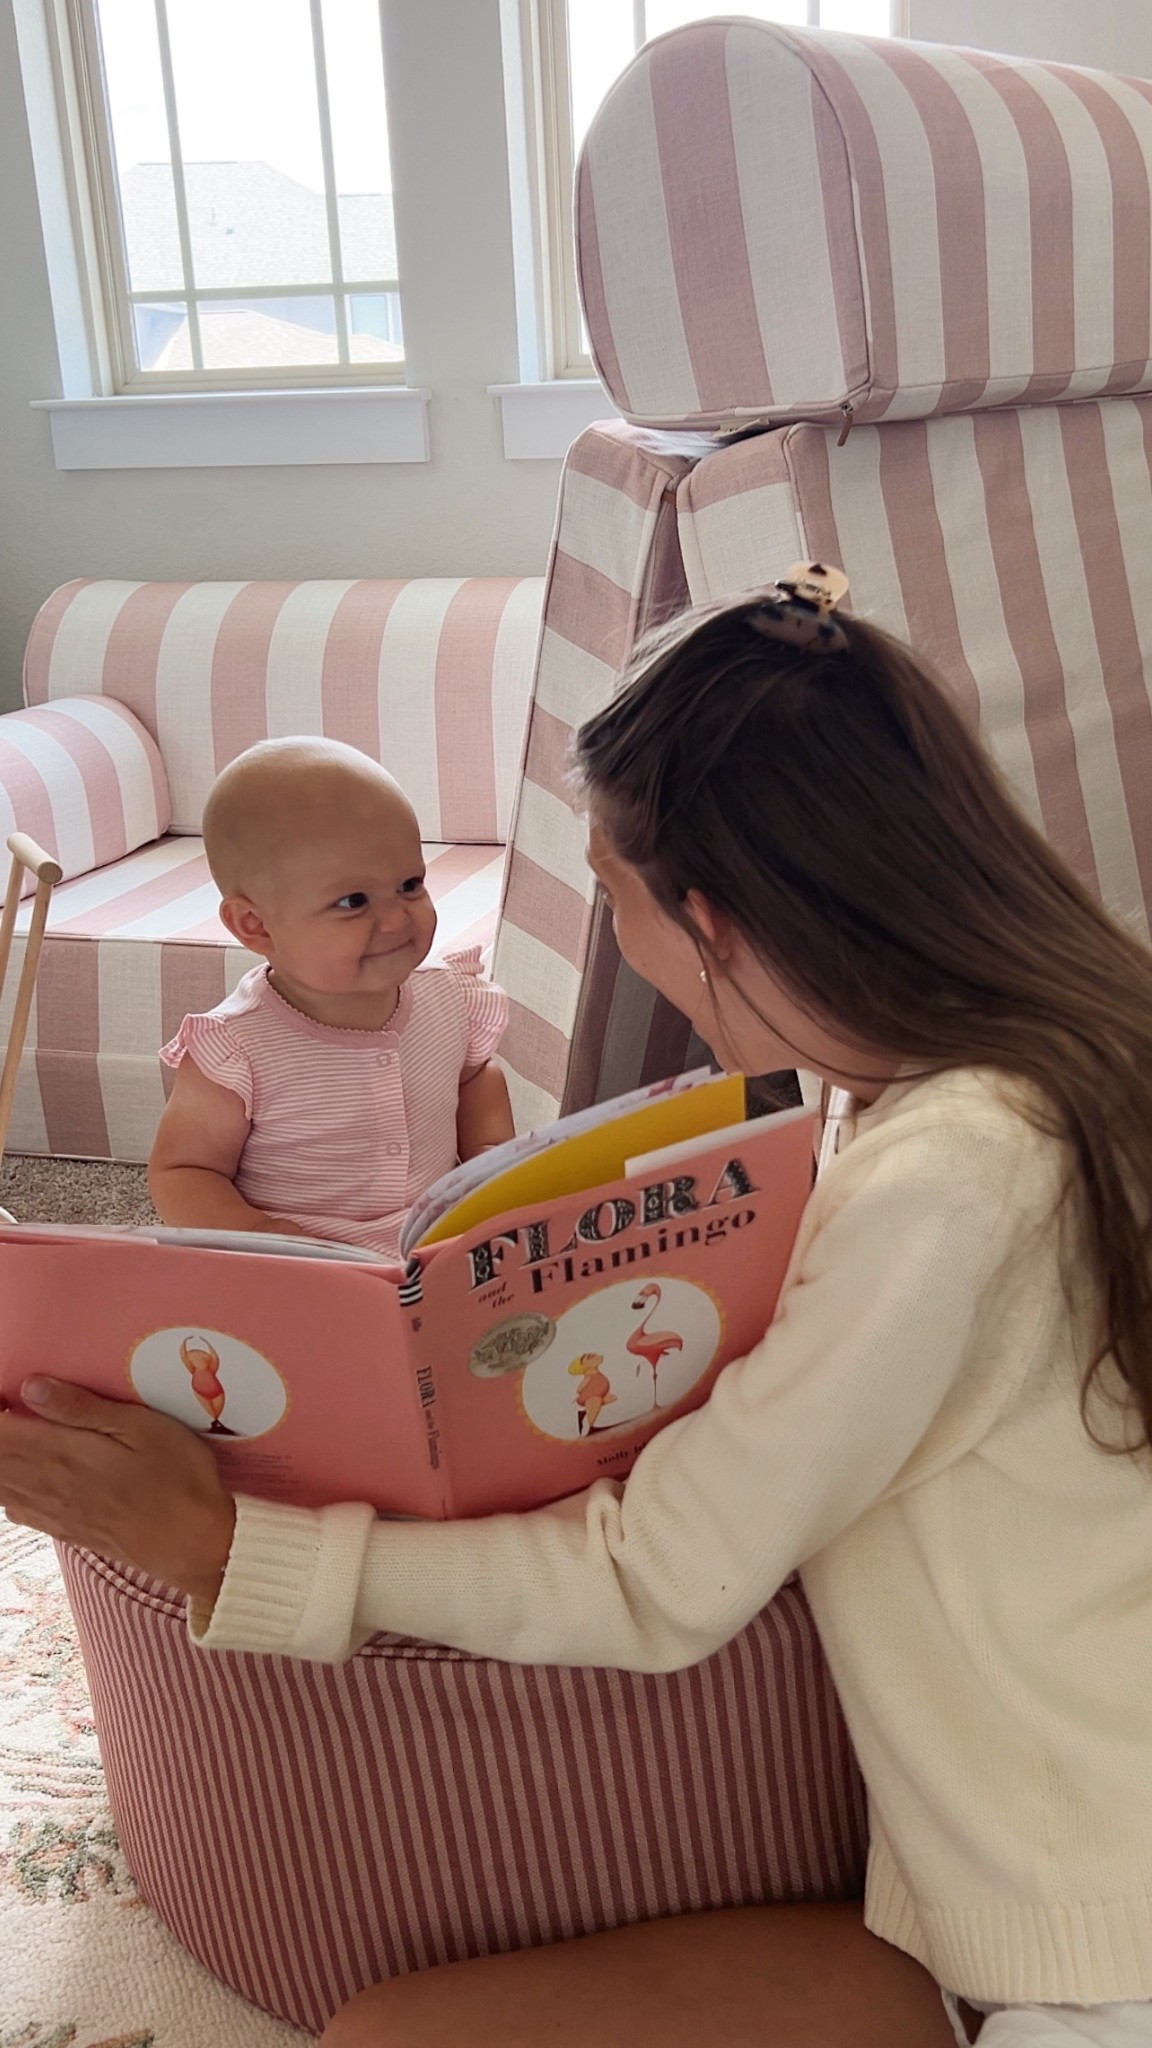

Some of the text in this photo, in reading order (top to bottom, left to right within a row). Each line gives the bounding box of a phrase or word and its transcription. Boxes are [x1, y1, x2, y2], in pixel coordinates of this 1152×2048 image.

[466, 1157, 762, 1294] FLORA
[530, 1208, 756, 1295] Flamingo
[416, 1366, 436, 1408] FLORA
